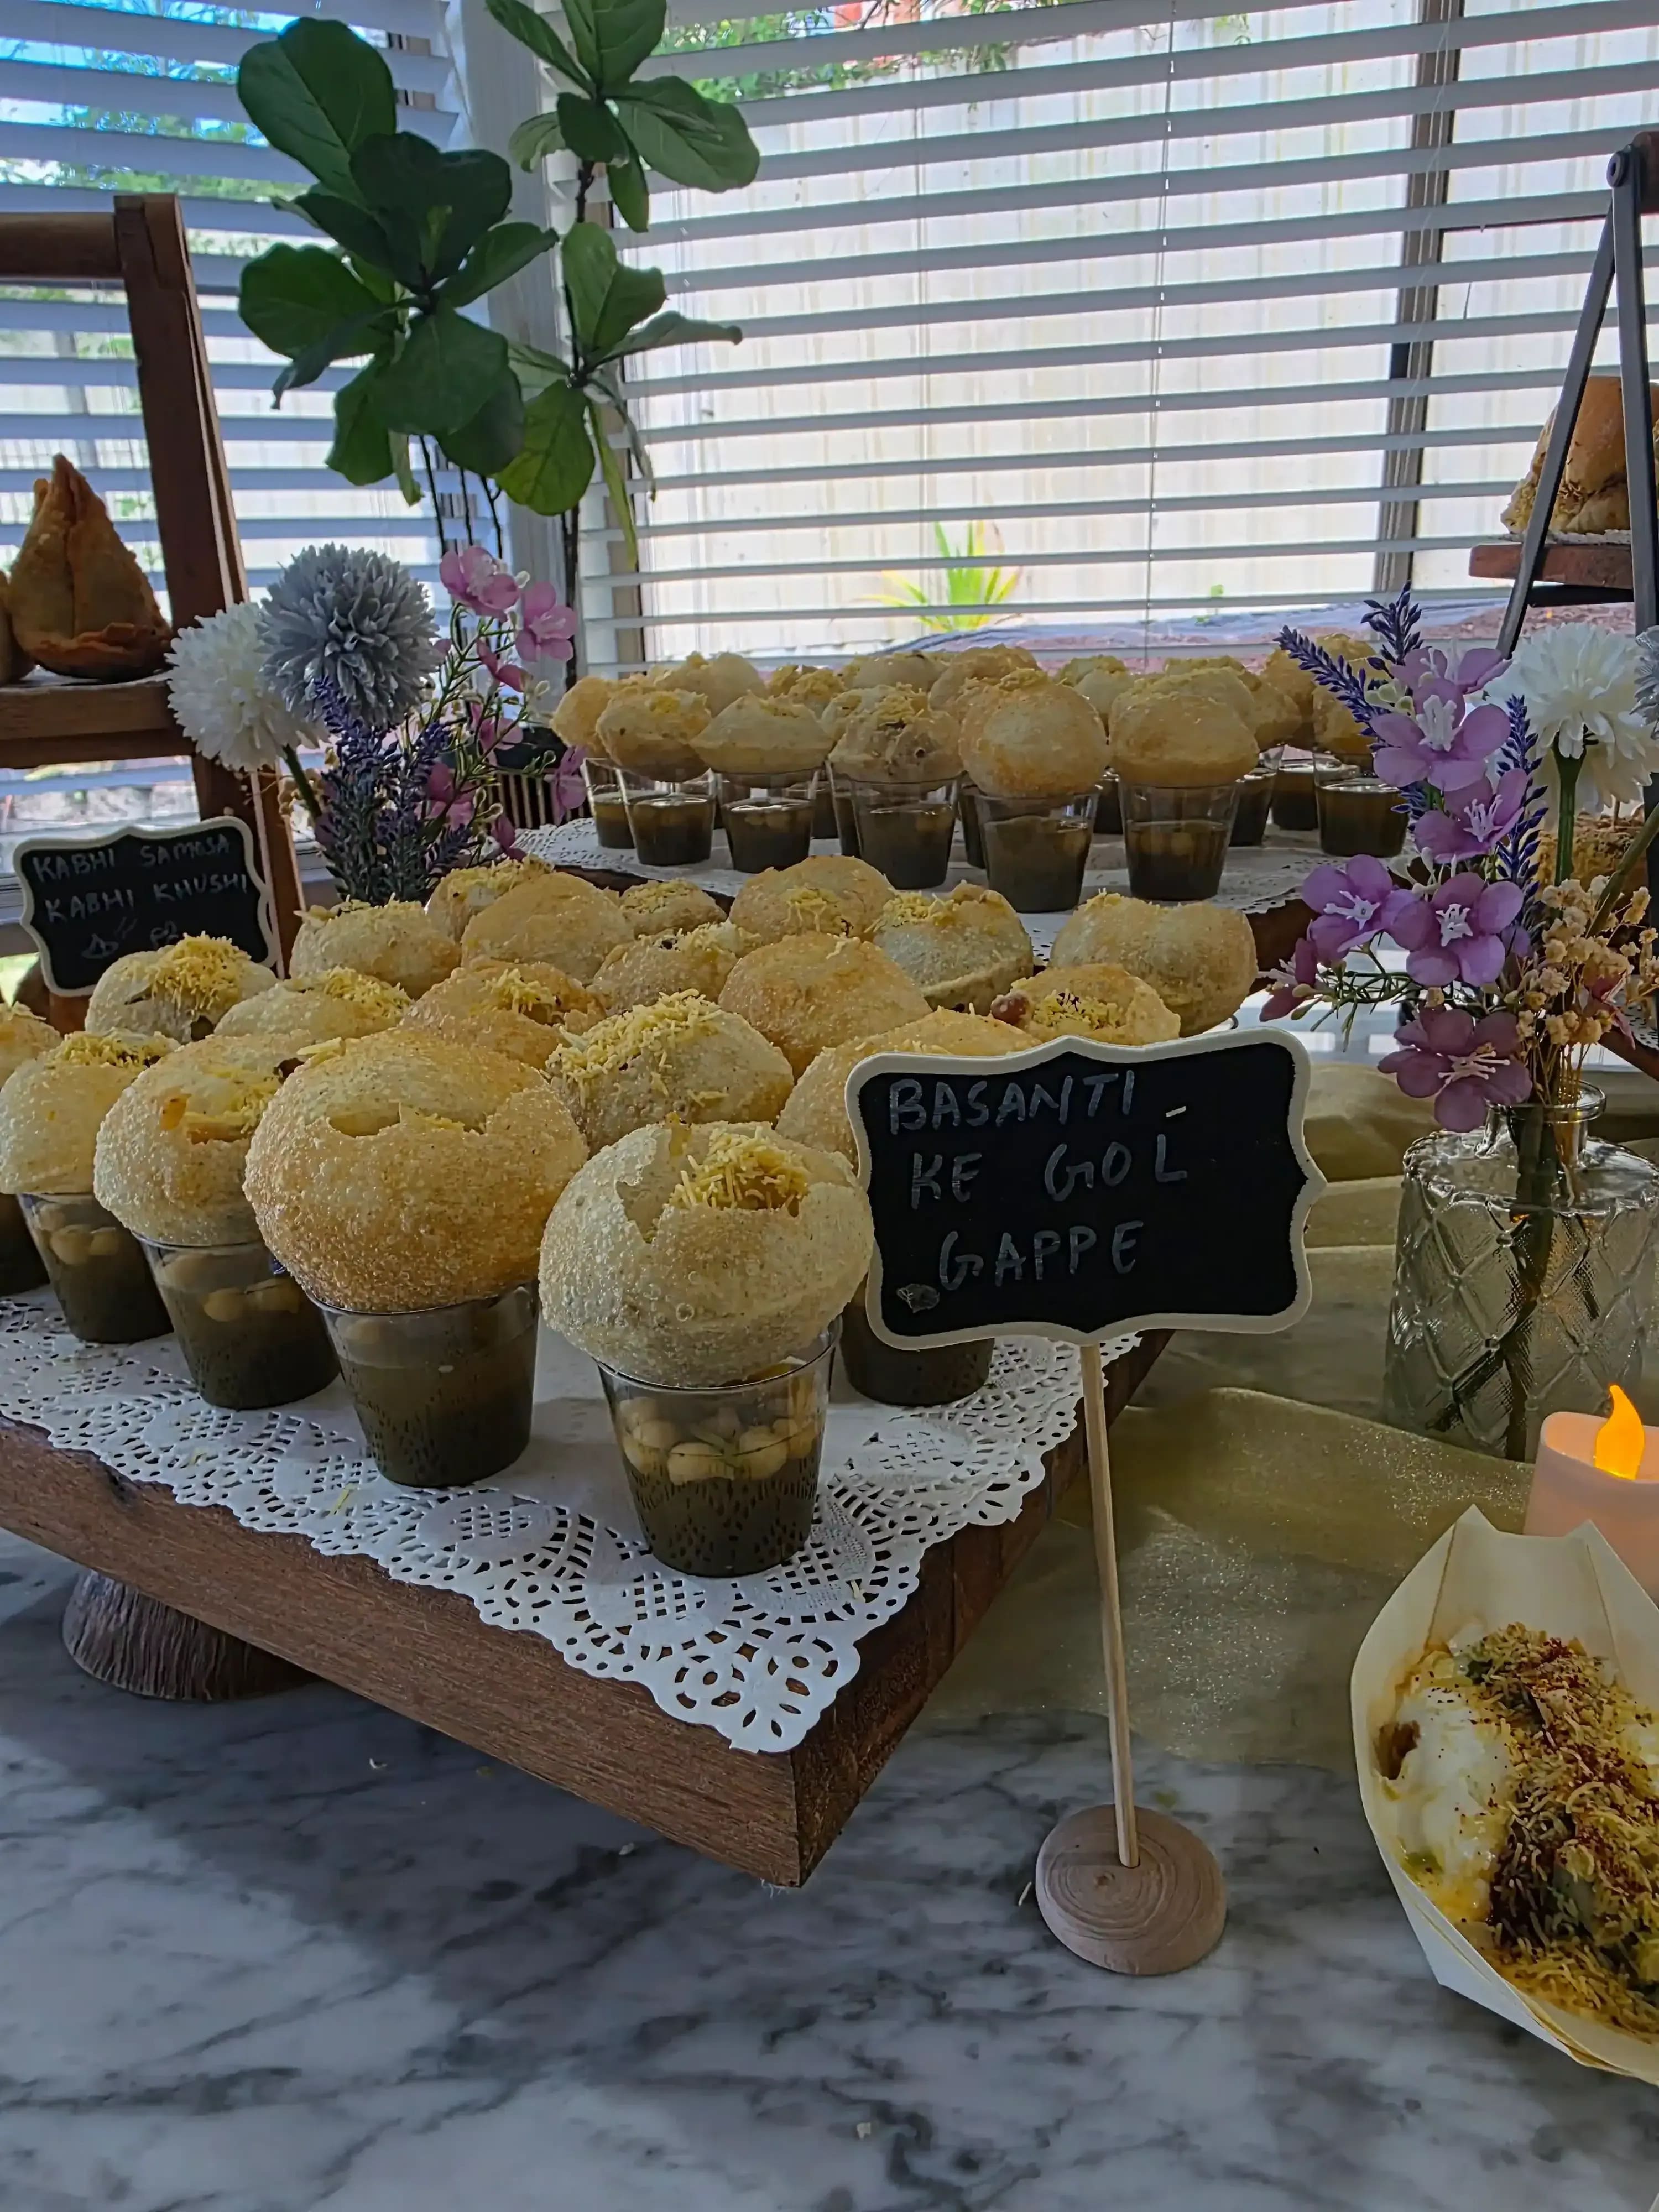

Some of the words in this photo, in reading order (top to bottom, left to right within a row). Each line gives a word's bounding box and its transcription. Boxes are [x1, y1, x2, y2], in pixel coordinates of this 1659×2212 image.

[33, 848, 115, 883] KABHI
[140, 833, 230, 867] SAMOSA
[44, 888, 135, 923] KABHI
[153, 872, 248, 903] KHUSHI
[889, 1070, 1135, 1136] BASANTI
[910, 1152, 983, 1210] KE
[1044, 1134, 1188, 1202] GOL
[938, 1220, 1144, 1291] GAPPE
